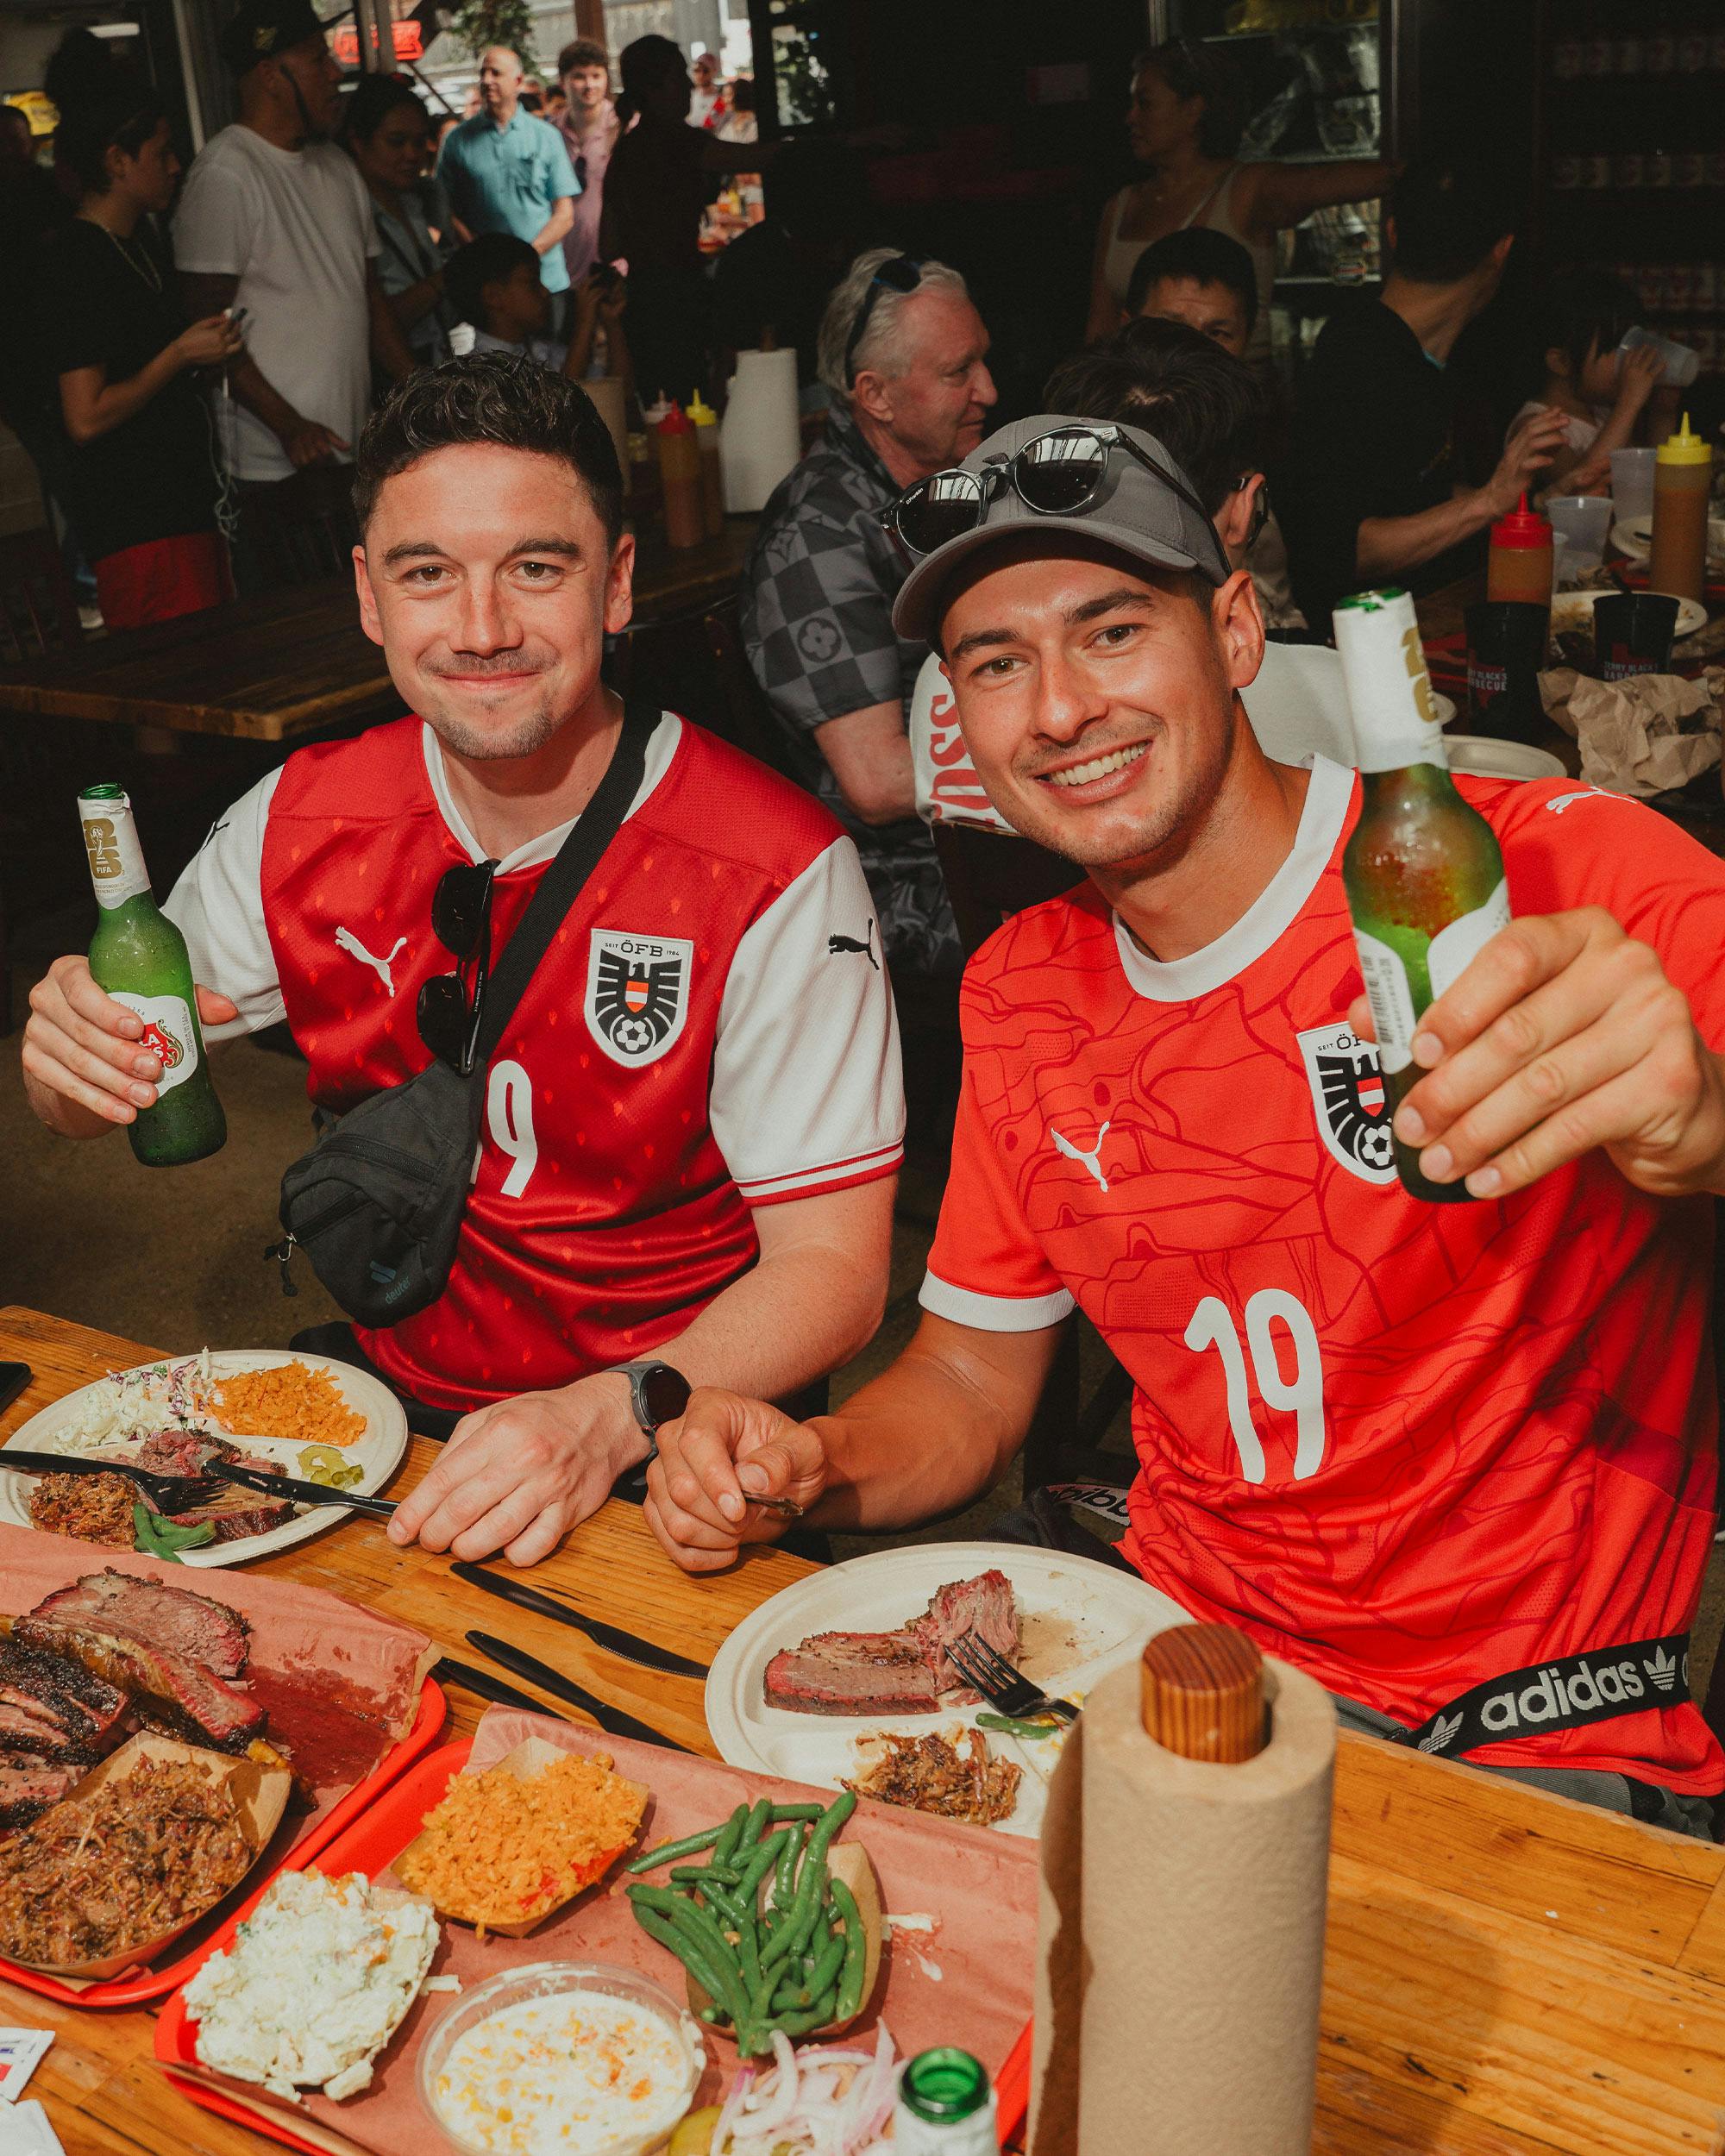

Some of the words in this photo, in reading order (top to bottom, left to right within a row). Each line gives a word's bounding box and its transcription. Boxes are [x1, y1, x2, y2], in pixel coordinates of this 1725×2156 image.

[620, 939, 663, 957] ÖFB
[1318, 1043, 1333, 1051] SEIT
[1184, 1288, 1326, 1485] 19
[1480, 1660, 1645, 1732] adidas
